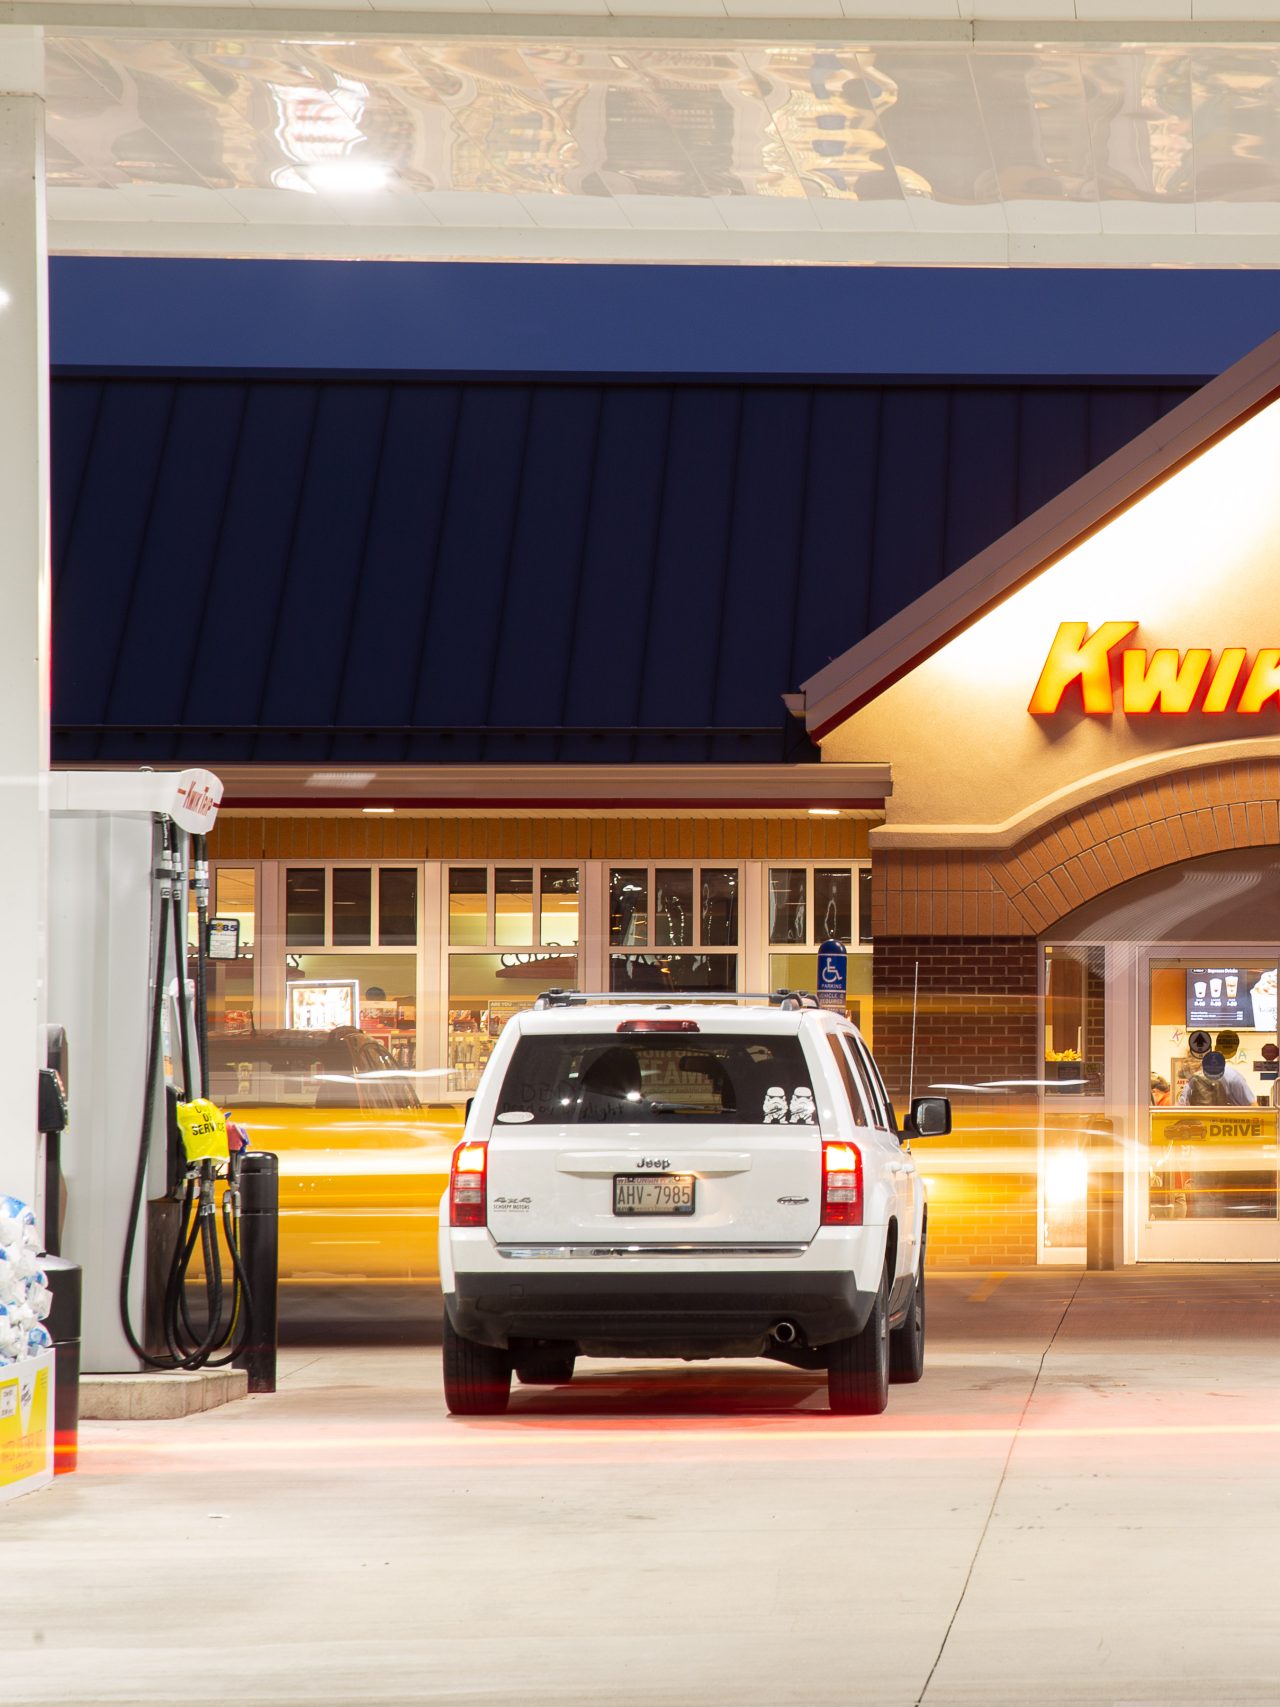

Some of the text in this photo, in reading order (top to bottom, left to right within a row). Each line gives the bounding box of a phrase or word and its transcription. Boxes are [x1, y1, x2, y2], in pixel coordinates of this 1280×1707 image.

[1209, 1125, 1261, 1137] DRIVE
[637, 1157, 670, 1170] Jeep
[617, 1186, 691, 1205] AHV-7985
